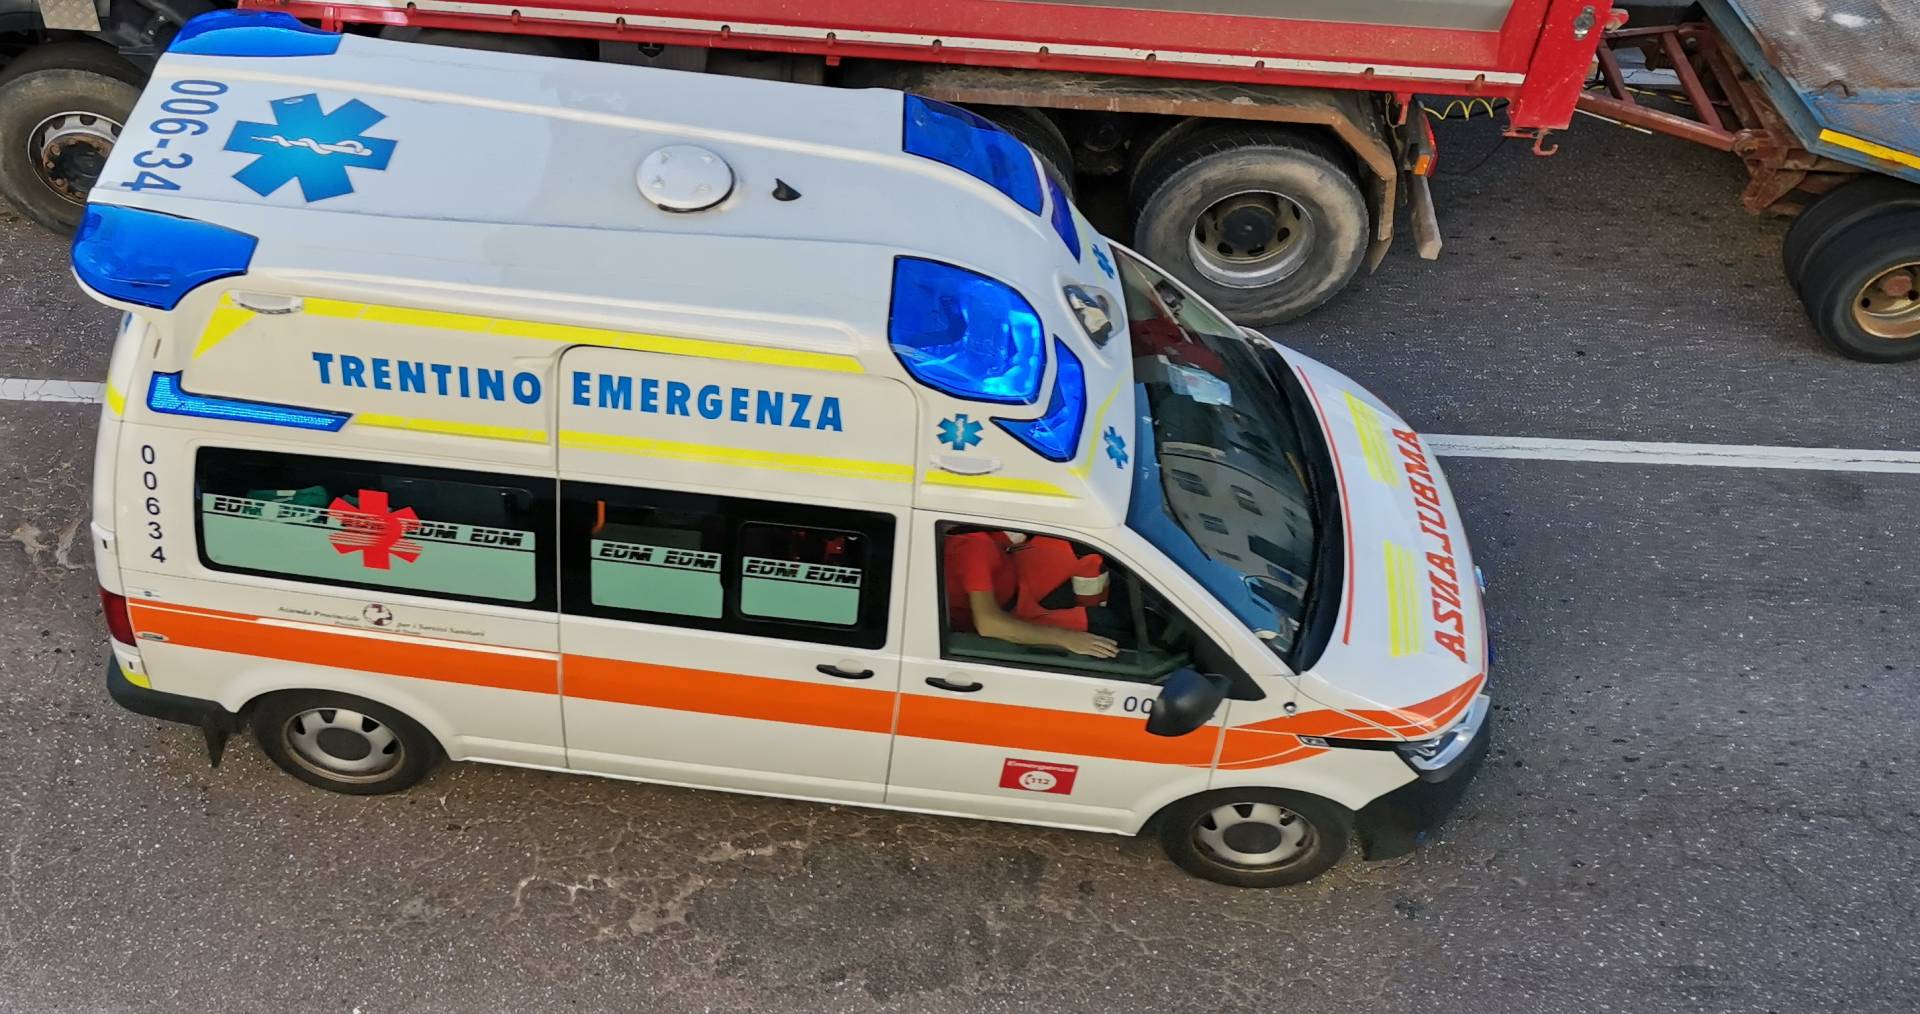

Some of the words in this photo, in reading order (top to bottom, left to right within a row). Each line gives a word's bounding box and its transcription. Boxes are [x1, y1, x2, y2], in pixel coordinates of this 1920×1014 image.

[121, 79, 229, 191] 006-34
[311, 351, 542, 404] TRENTINO
[571, 370, 844, 432] EMERGENZA
[213, 497, 266, 517] EDM
[404, 521, 459, 540] EDM
[470, 527, 524, 547] EDM
[600, 543, 654, 562] EDM
[663, 549, 719, 570] EDM
[744, 559, 800, 578] EDM
[804, 565, 860, 585] EDM
